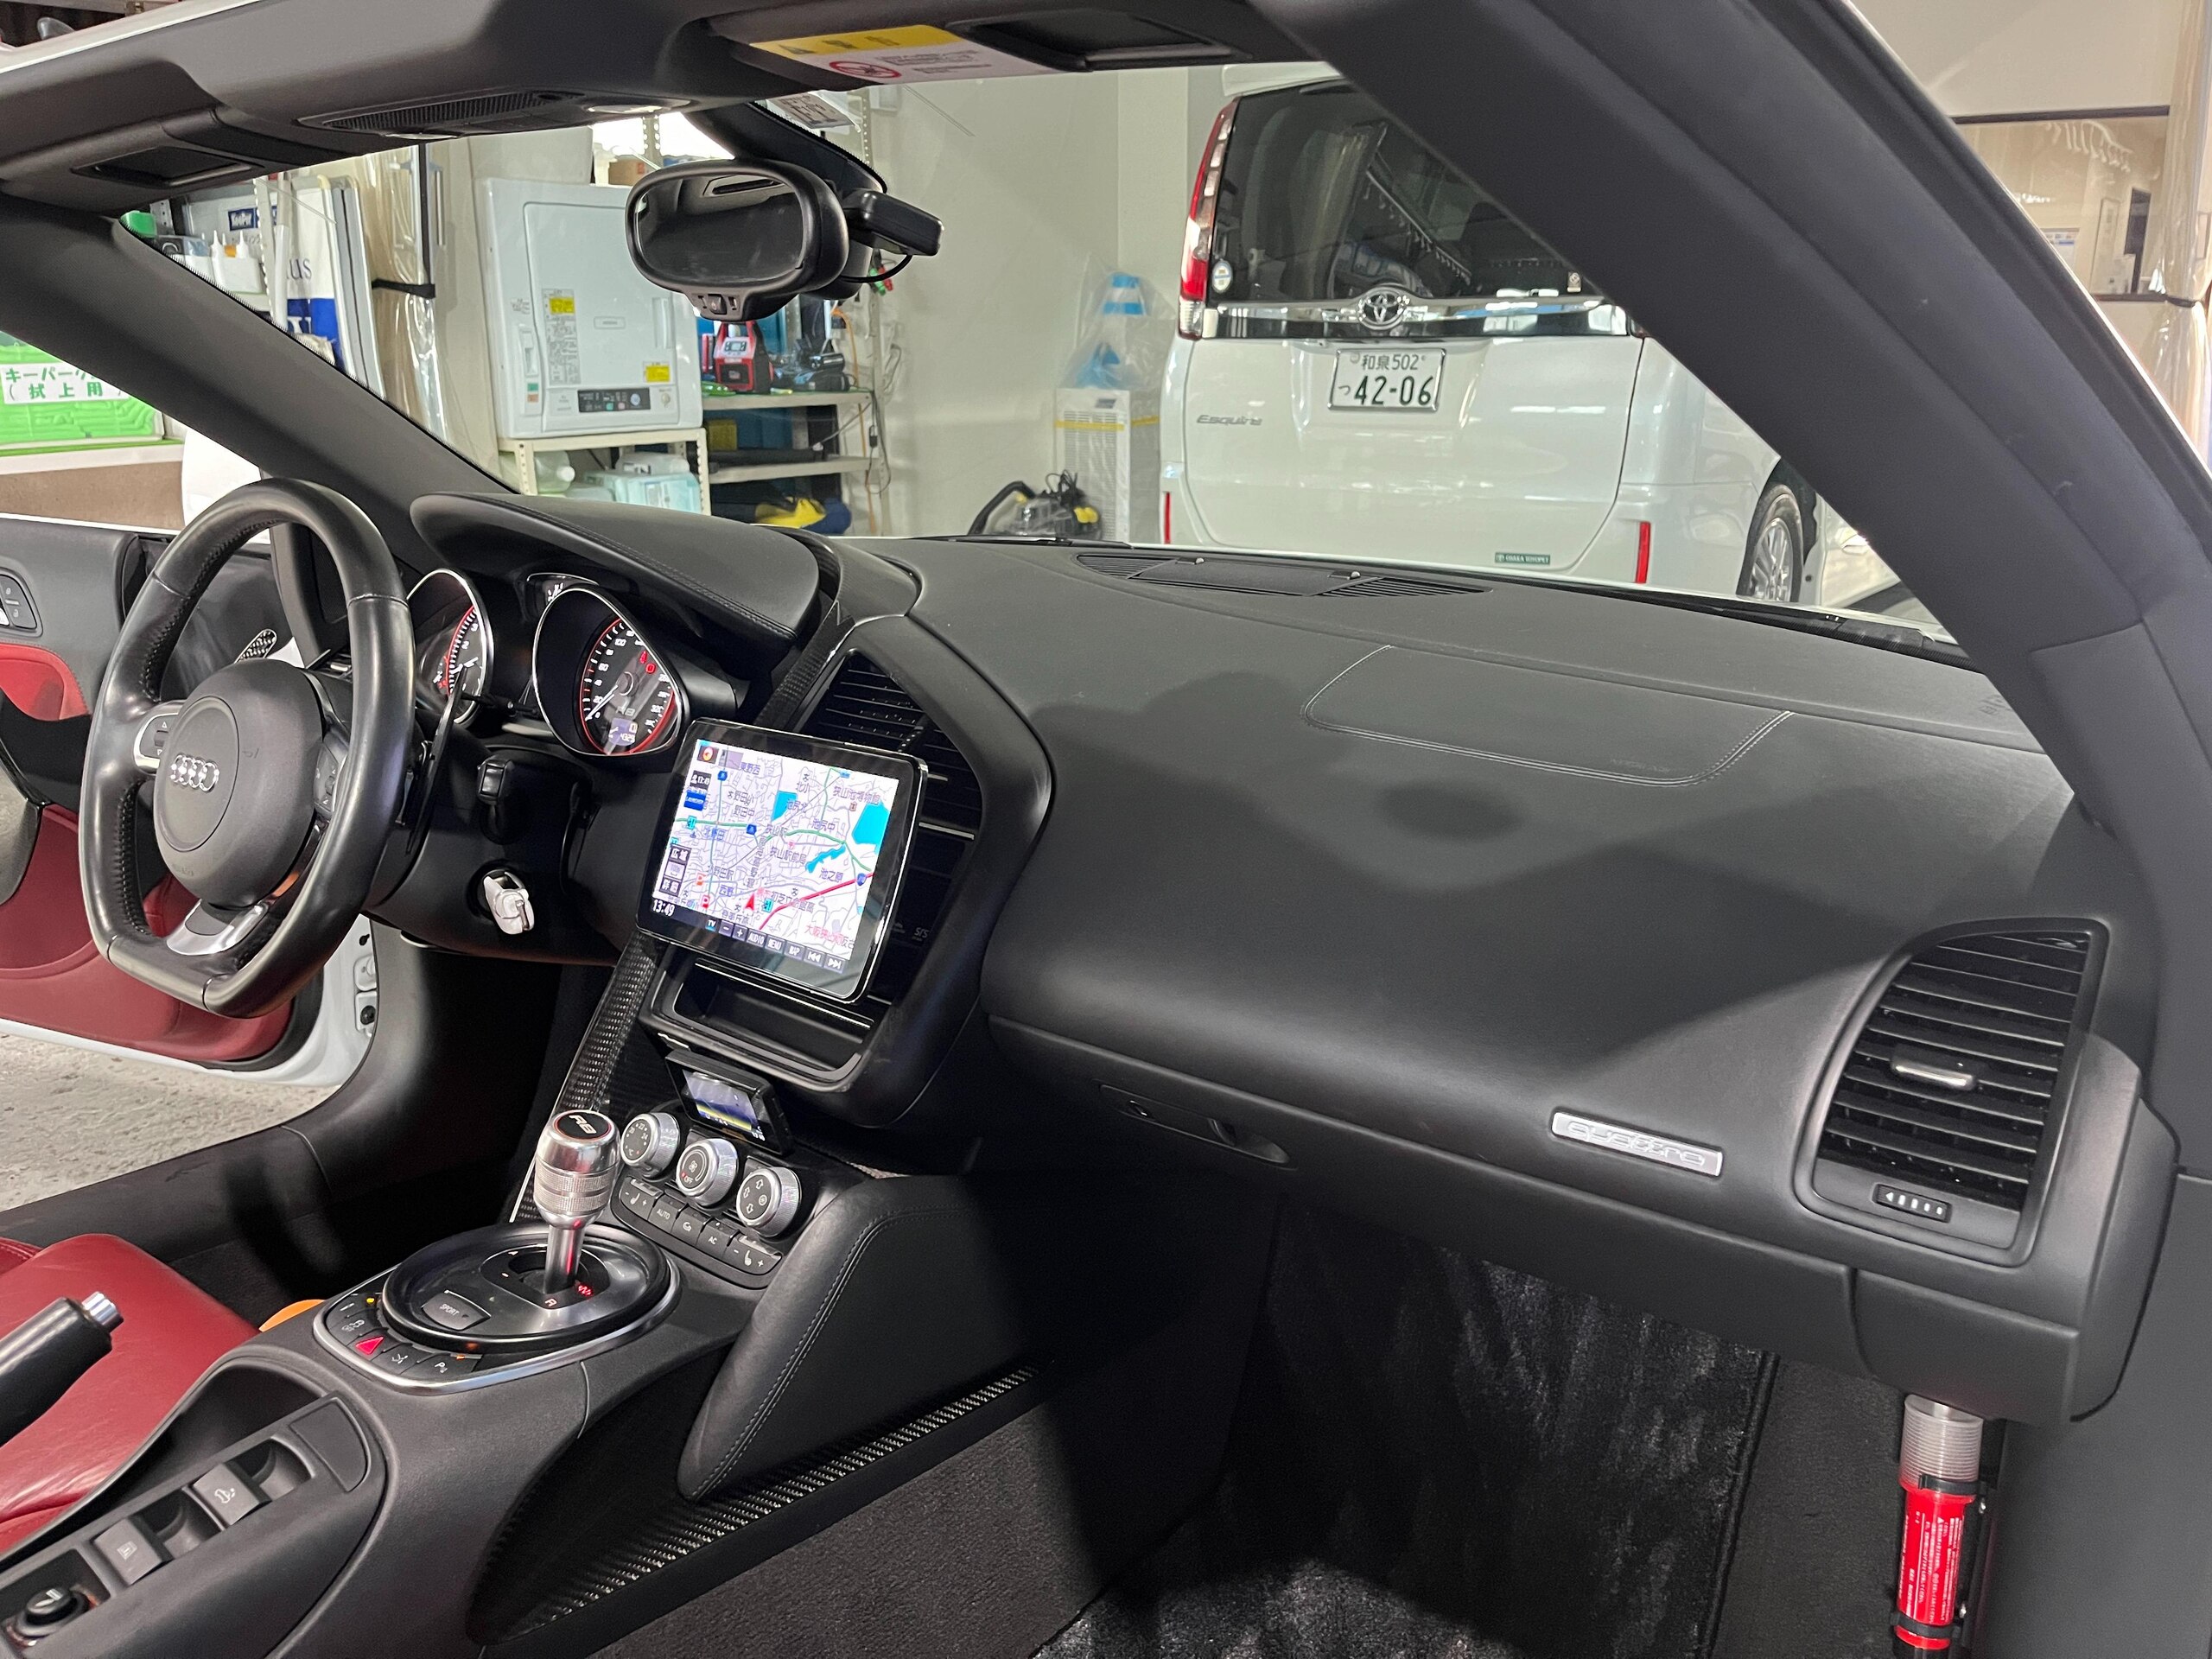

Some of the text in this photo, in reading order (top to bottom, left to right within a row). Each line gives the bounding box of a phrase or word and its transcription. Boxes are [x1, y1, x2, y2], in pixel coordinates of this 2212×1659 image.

[1338, 375, 1433, 405] つ 42-06
[734, 804, 755, 818] 野田中
[812, 818, 836, 831] 池尻中
[652, 899, 675, 917] 13:49
[747, 932, 765, 945] AUDIO
[767, 939, 782, 950] MENU
[569, 1115, 597, 1135] R8
[1567, 1121, 1707, 1166] quattro
[683, 1176, 694, 1185] OFF
[657, 1208, 671, 1220] AUTO
[708, 1236, 717, 1245] AC
[544, 1298, 557, 1307] R
[439, 1303, 460, 1317] SPORT
